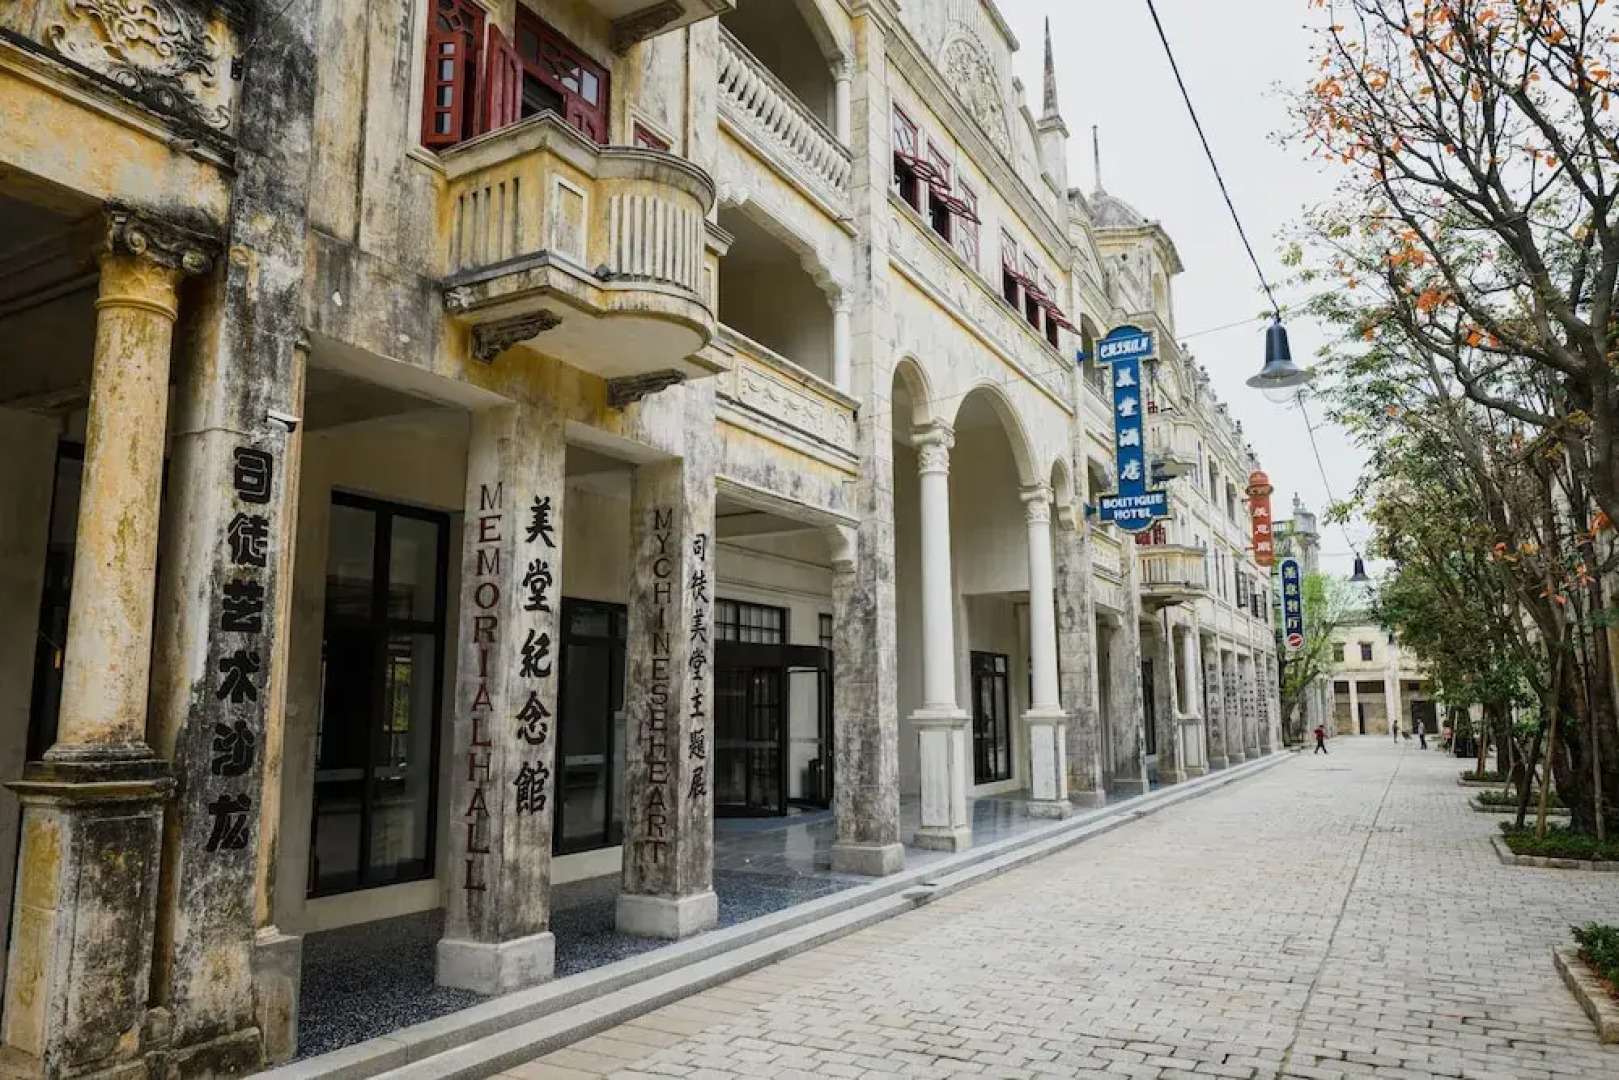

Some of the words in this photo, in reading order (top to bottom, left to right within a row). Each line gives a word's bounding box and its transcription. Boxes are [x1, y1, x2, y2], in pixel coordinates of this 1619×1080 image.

[1102, 493, 1164, 509] BOUTIQUE
[1113, 507, 1153, 520] HOTEL
[206, 446, 272, 852] 司徒艺术沙龙
